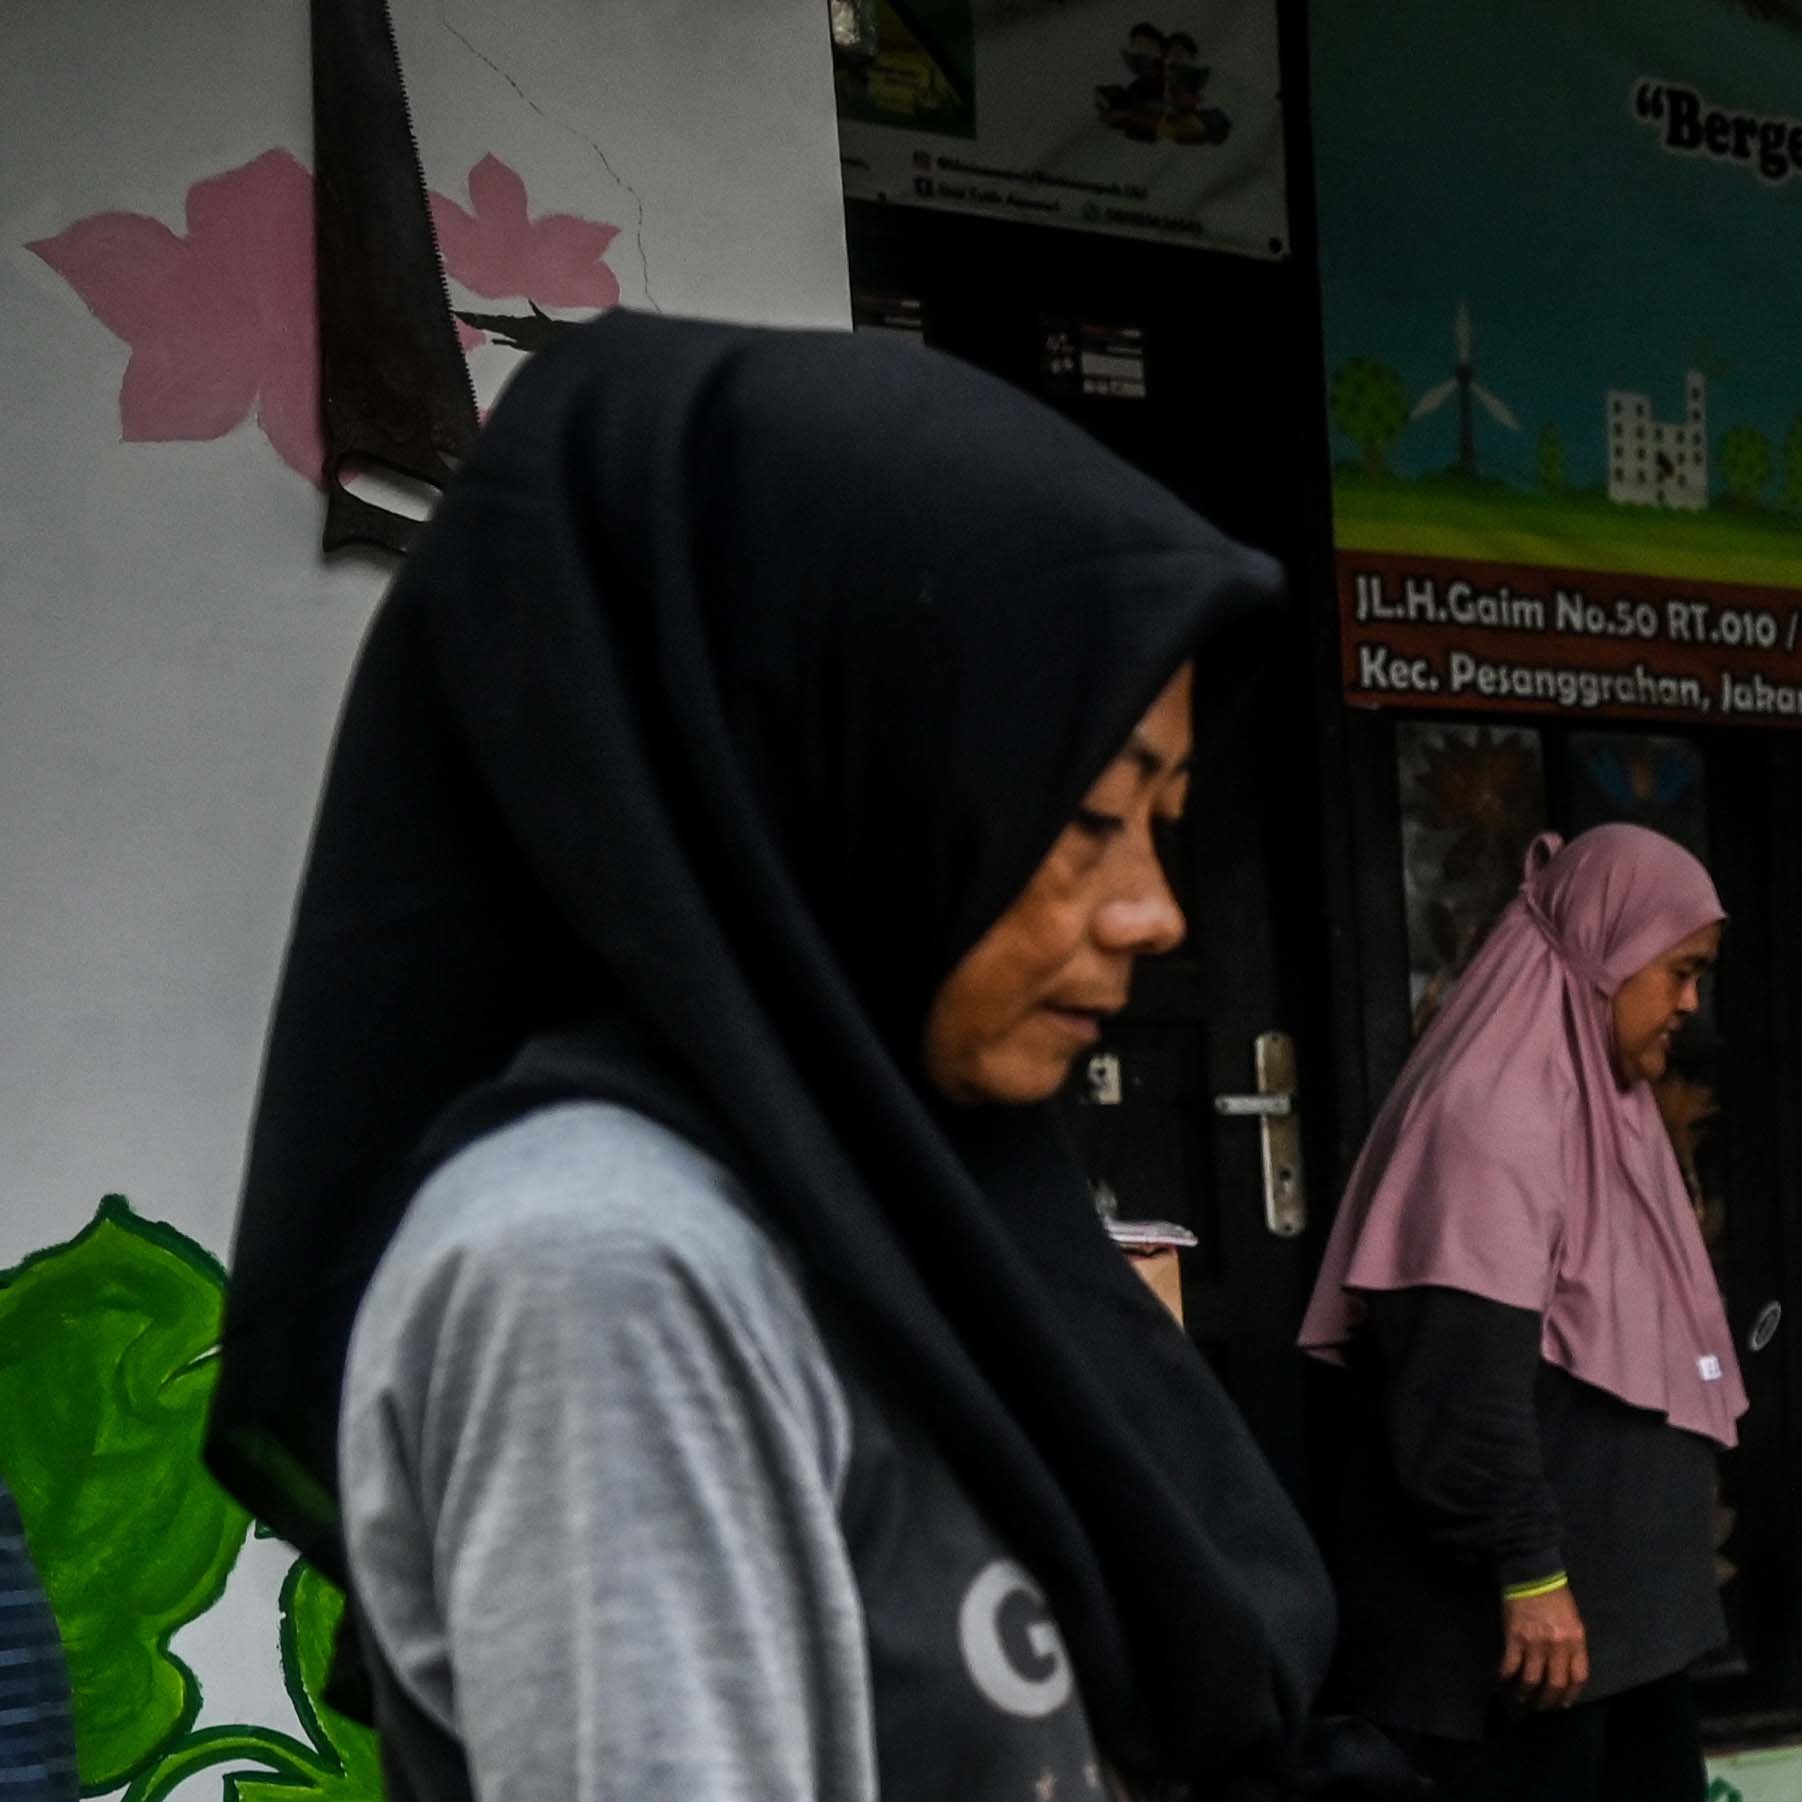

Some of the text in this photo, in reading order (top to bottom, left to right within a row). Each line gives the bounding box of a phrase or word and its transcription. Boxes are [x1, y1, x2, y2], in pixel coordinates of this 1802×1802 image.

[1355, 573, 1545, 632] JL.H.Gaim
[1554, 589, 1659, 639] No.50
[1667, 599, 1778, 648] RT.010
[1785, 611, 1799, 651] /
[1358, 646, 1441, 692] Kec.
[1450, 650, 1712, 712] Pesanggrahan,
